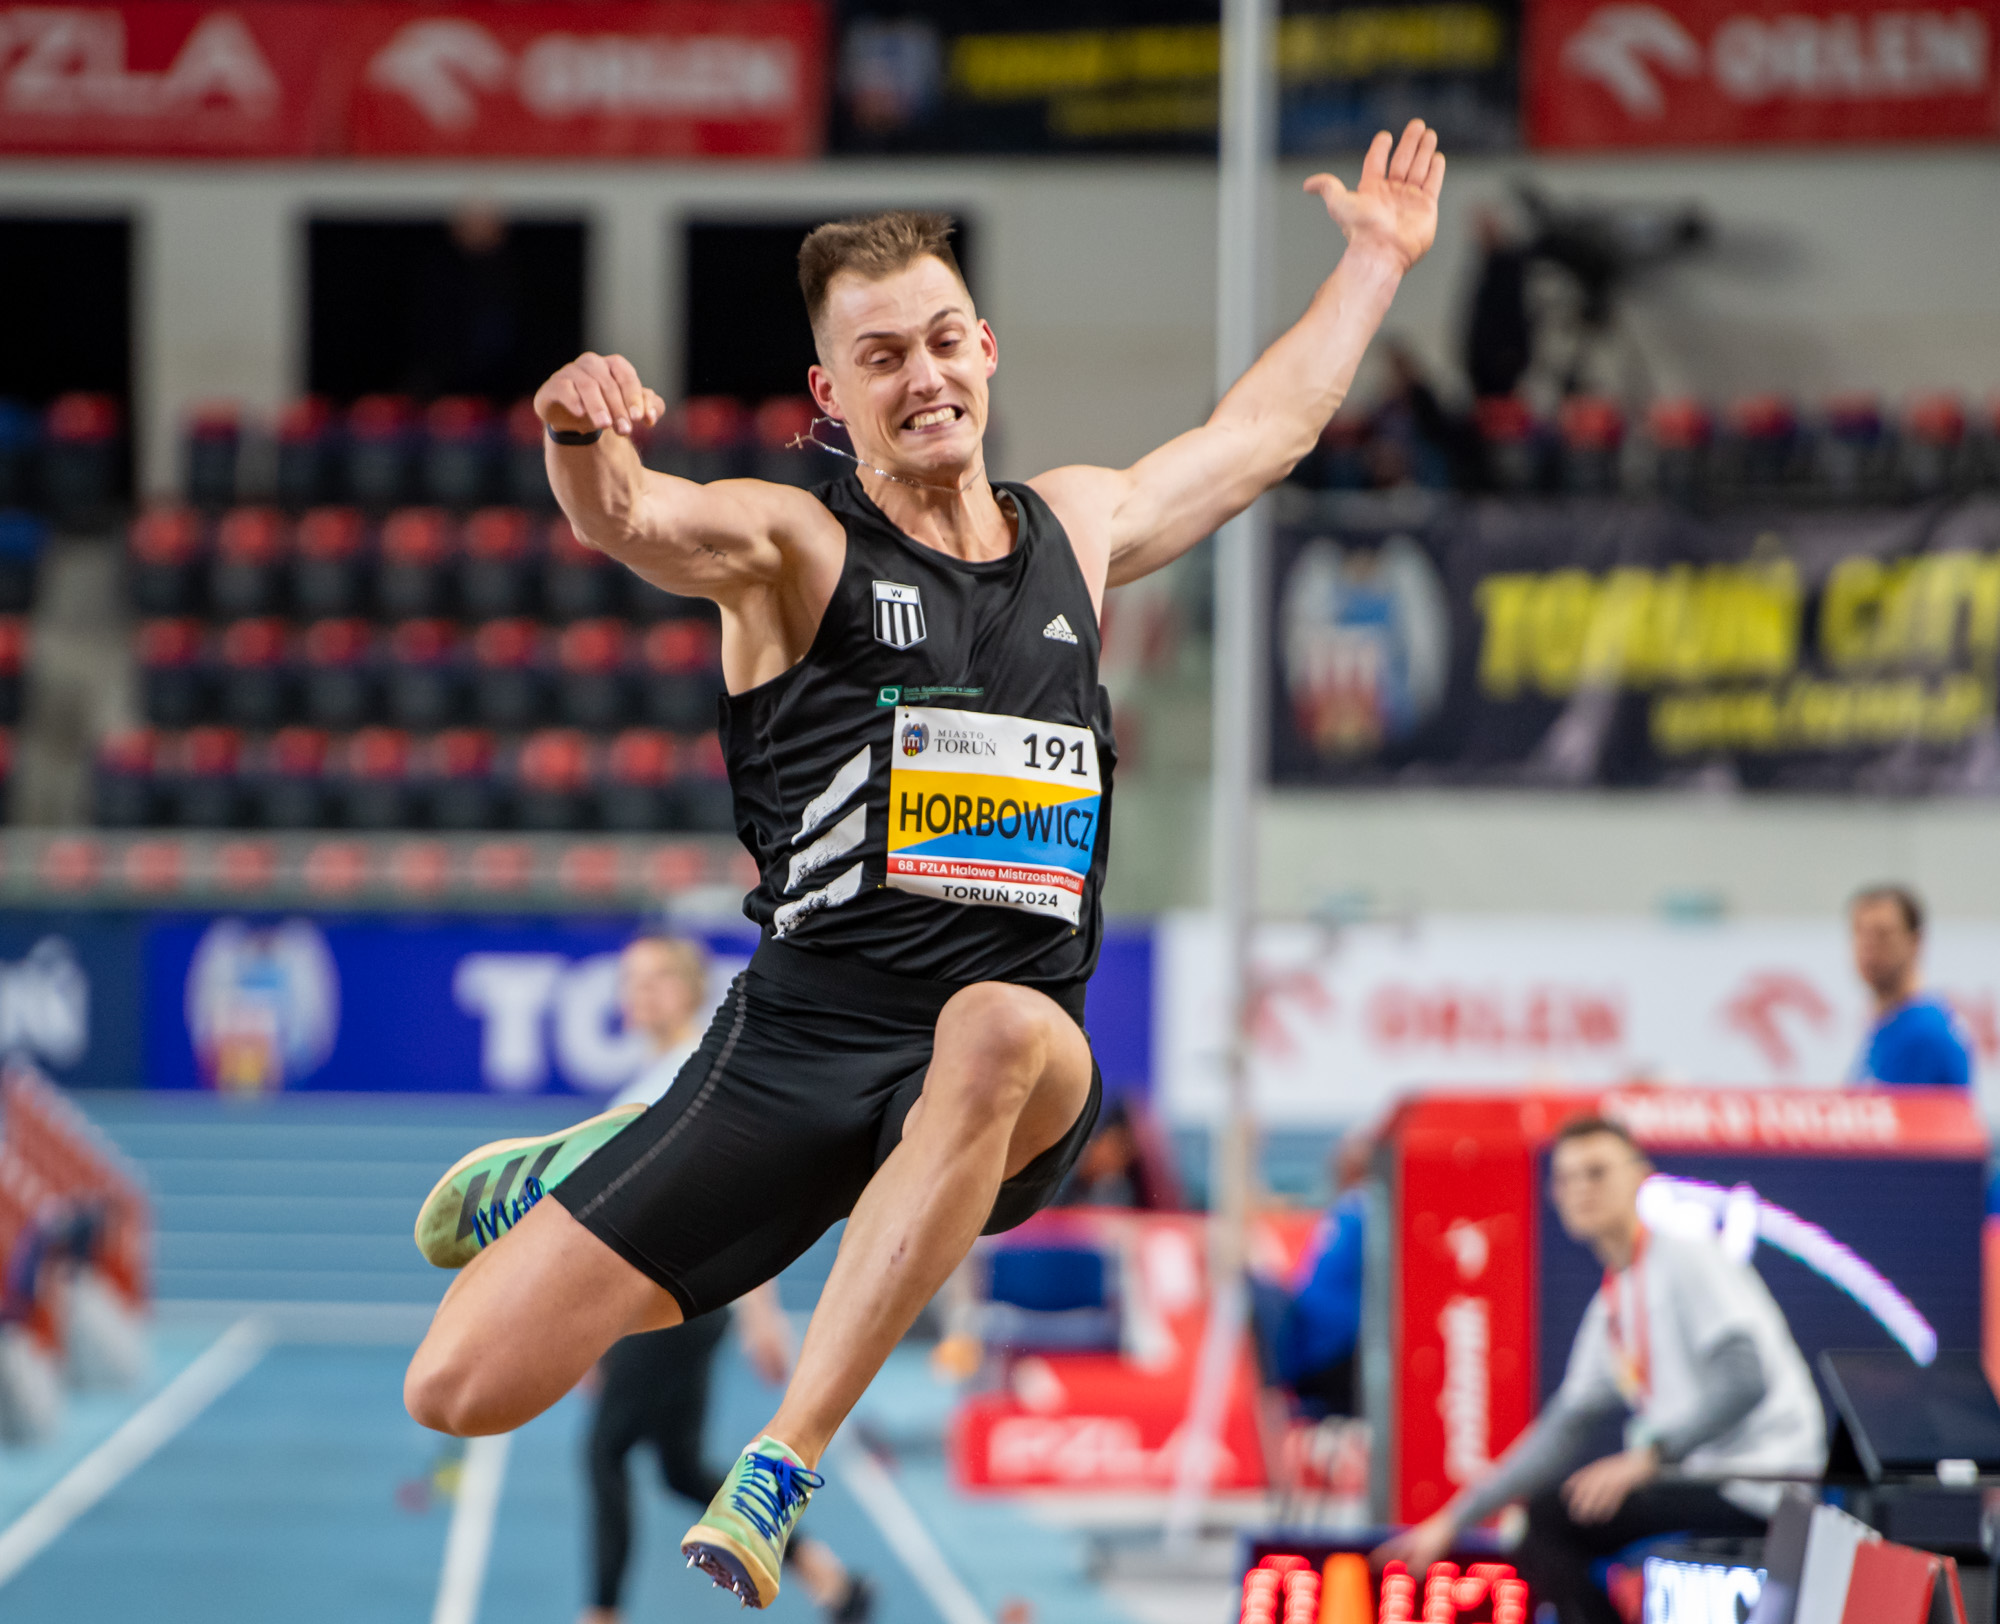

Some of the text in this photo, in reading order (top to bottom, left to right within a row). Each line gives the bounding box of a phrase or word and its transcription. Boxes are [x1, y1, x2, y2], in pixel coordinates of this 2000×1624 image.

[1712, 13, 1988, 103] ORLEN
[891, 588, 902, 598] W
[1043, 628, 1078, 645] adidas
[937, 729, 984, 739] MIASTO
[934, 737, 997, 756] TORUŃ
[1023, 732, 1088, 776] 191
[899, 791, 1094, 852] HORBOWICZ
[898, 859, 917, 872] 68.
[919, 861, 948, 874] PZLA
[950, 865, 996, 878] Halowe
[998, 868, 1065, 885] Mistrzostwa
[942, 885, 1058, 908] TORUŃ 2024
